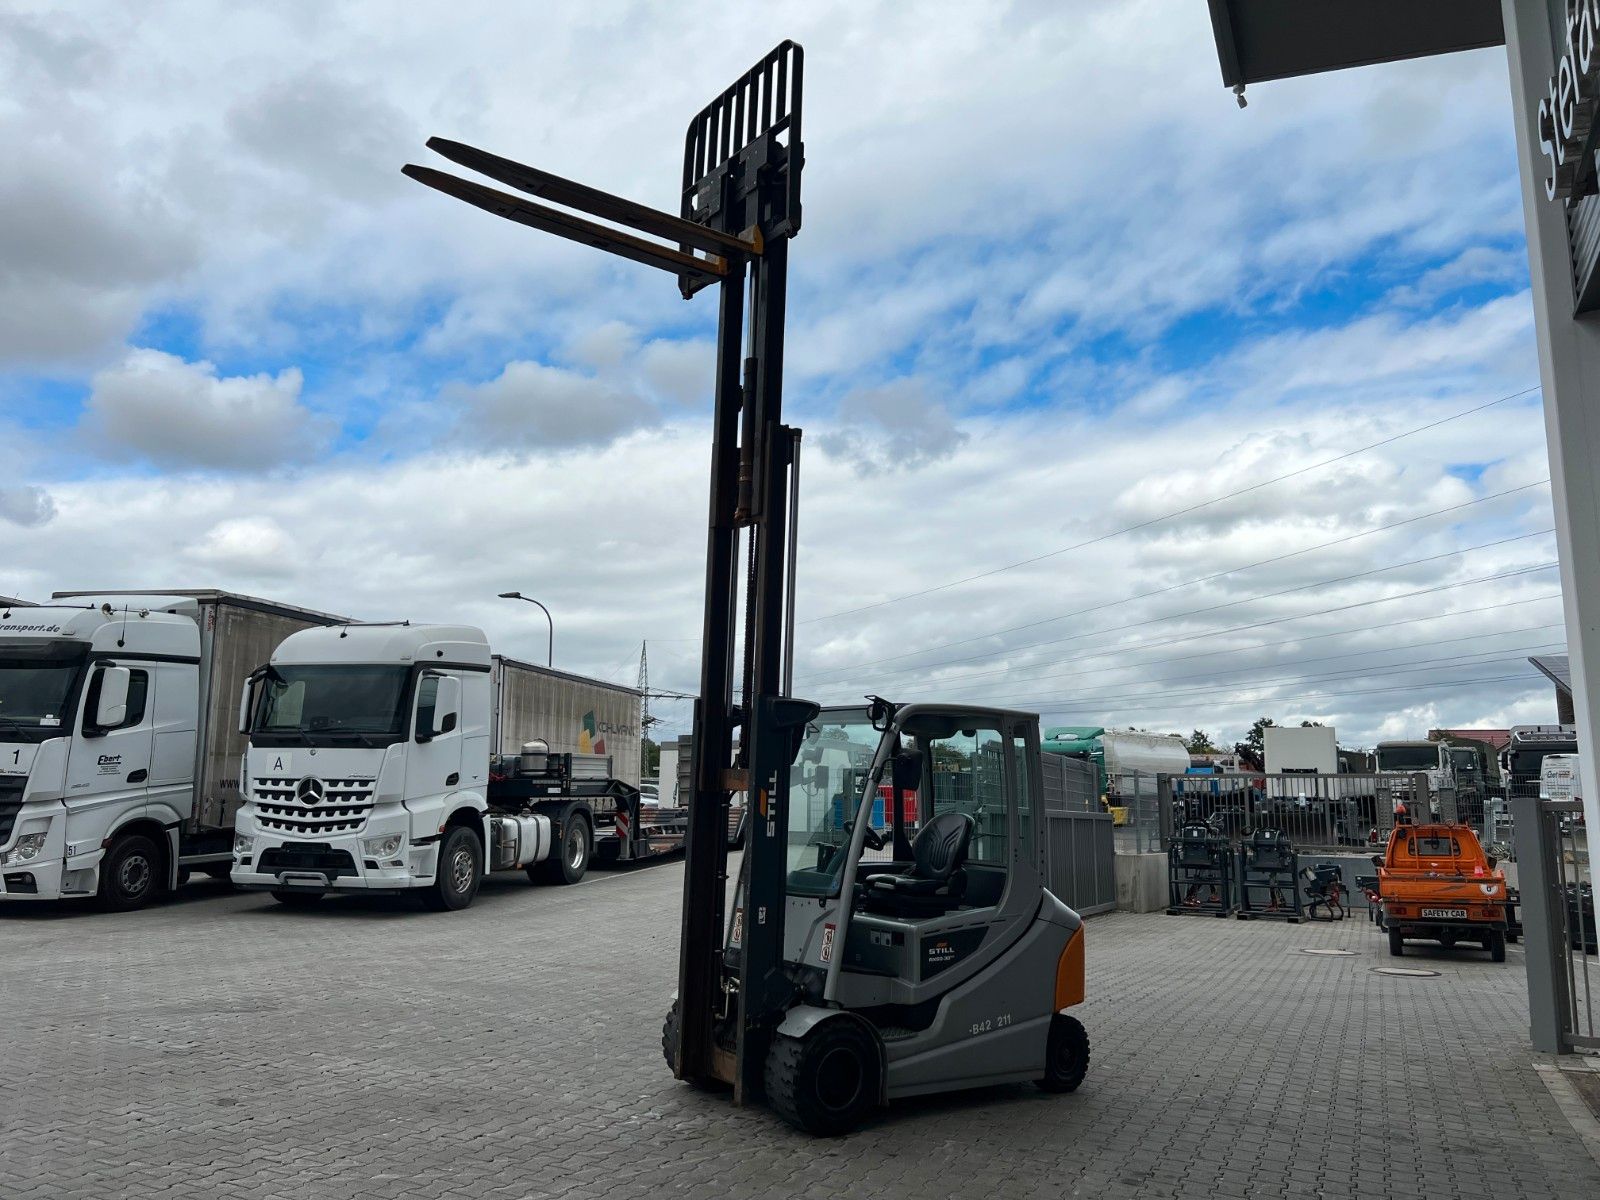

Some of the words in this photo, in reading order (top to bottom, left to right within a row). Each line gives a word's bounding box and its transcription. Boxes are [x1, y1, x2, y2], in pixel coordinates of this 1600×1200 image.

[1537, 0, 1600, 202] Stefa
[0, 624, 61, 633] ransport.de
[12, 749, 21, 765] 1
[273, 756, 283, 771] A
[766, 769, 778, 837] STILL
[1423, 909, 1449, 917] SAFETY
[1450, 909, 1466, 918] CAR
[928, 947, 956, 955] STILL
[997, 1013, 1011, 1027] 211
